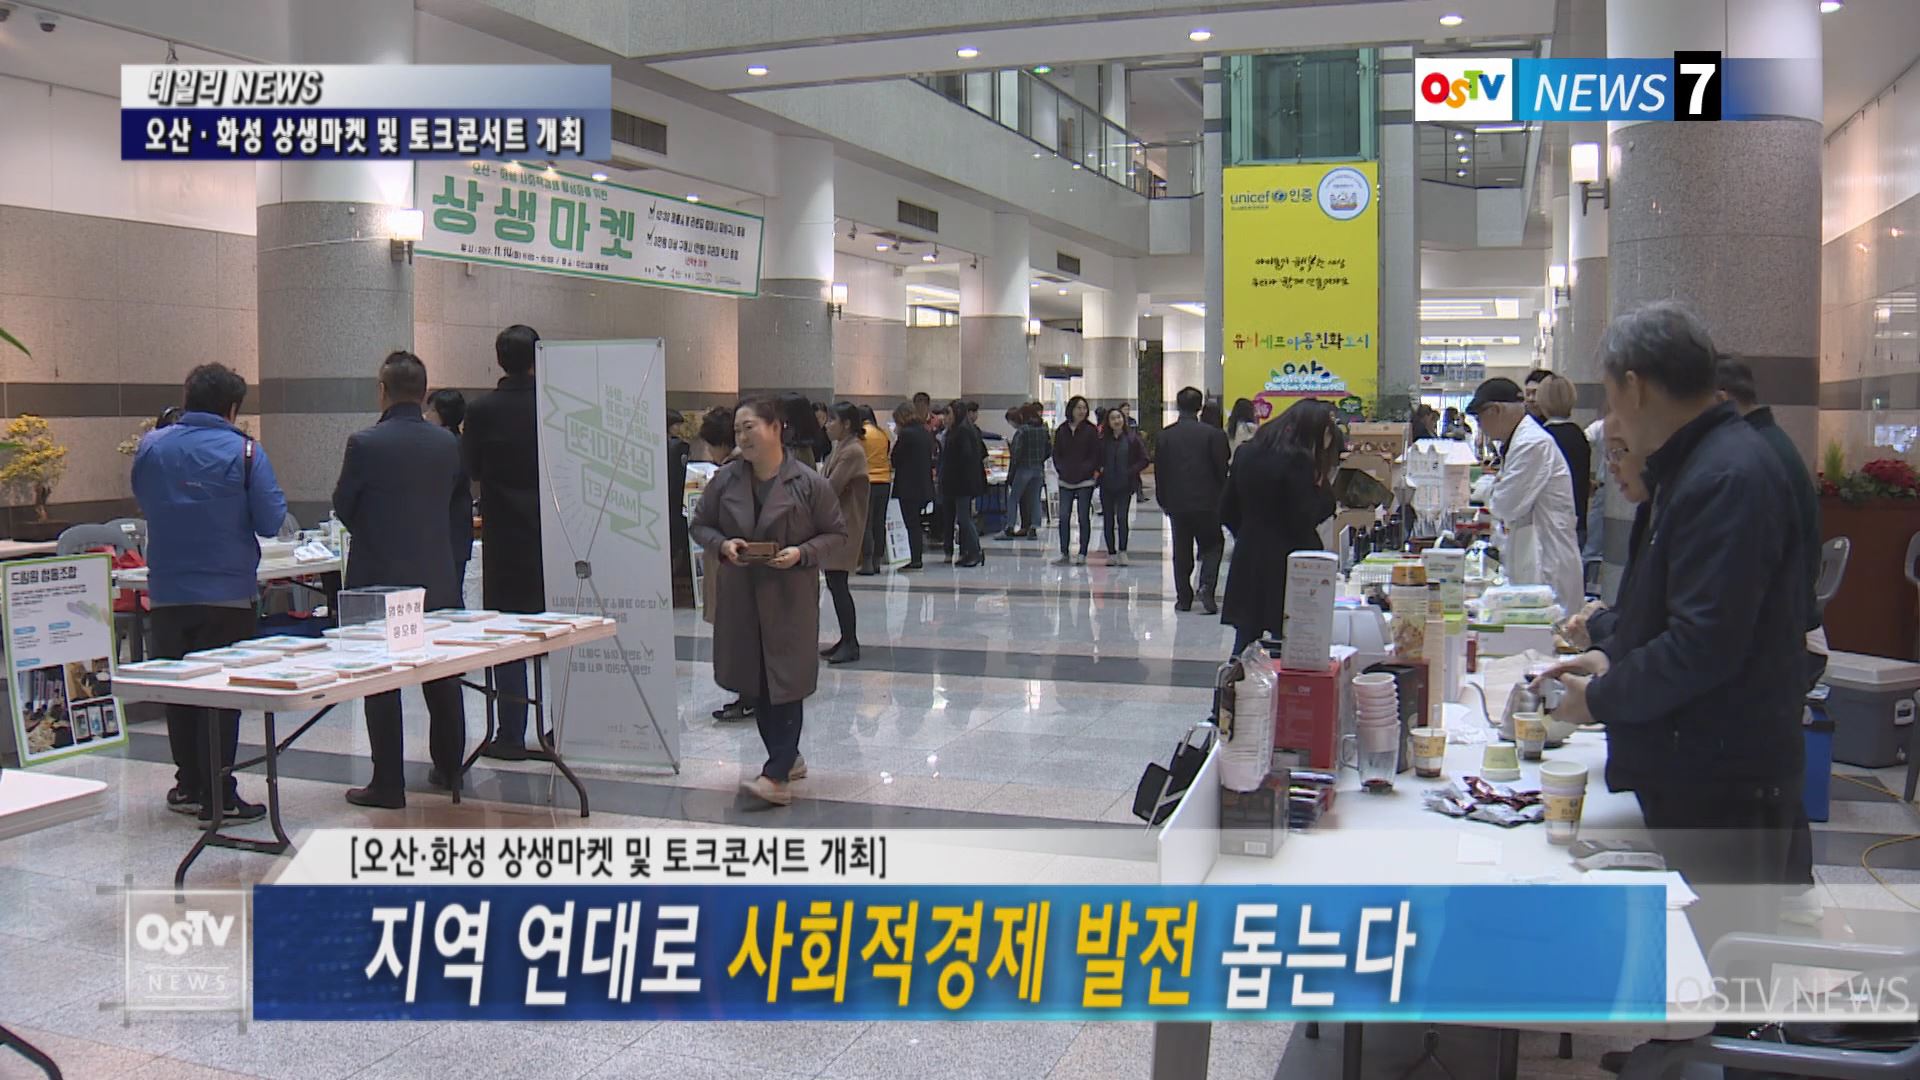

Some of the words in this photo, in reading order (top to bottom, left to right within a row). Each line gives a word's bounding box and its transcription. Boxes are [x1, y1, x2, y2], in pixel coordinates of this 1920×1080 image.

[1231, 189, 1270, 205] unicef
[1289, 187, 1313, 203] 인증
[432, 175, 635, 259] 상생마켓
